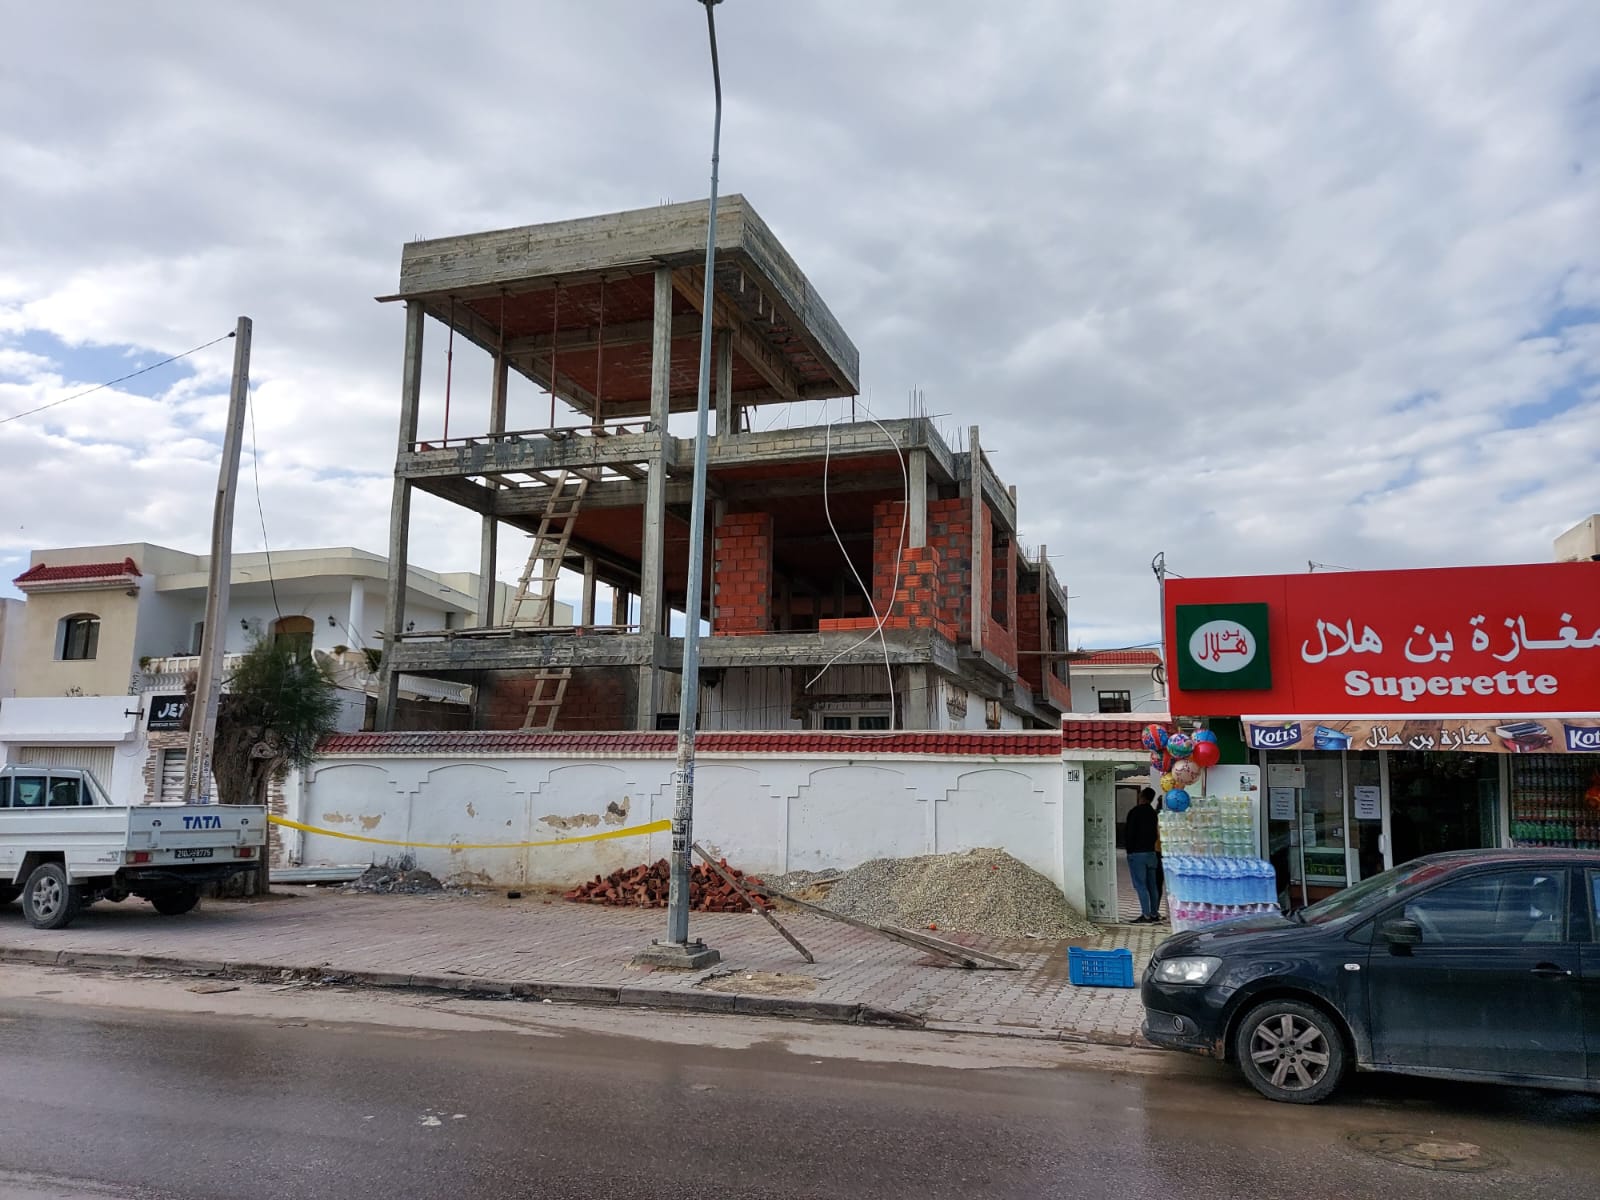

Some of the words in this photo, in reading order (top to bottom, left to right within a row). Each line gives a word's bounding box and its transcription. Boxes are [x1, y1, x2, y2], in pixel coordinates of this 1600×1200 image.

[1301, 618, 1383, 664] هلال
[1404, 624, 1454, 663] بن
[1344, 670, 1559, 702] Superette
[1254, 725, 1298, 746] Kotis
[1366, 725, 1403, 748] هلال
[1409, 730, 1435, 750] بن
[1440, 726, 1492, 751] مغازة
[183, 815, 222, 829] TATA
